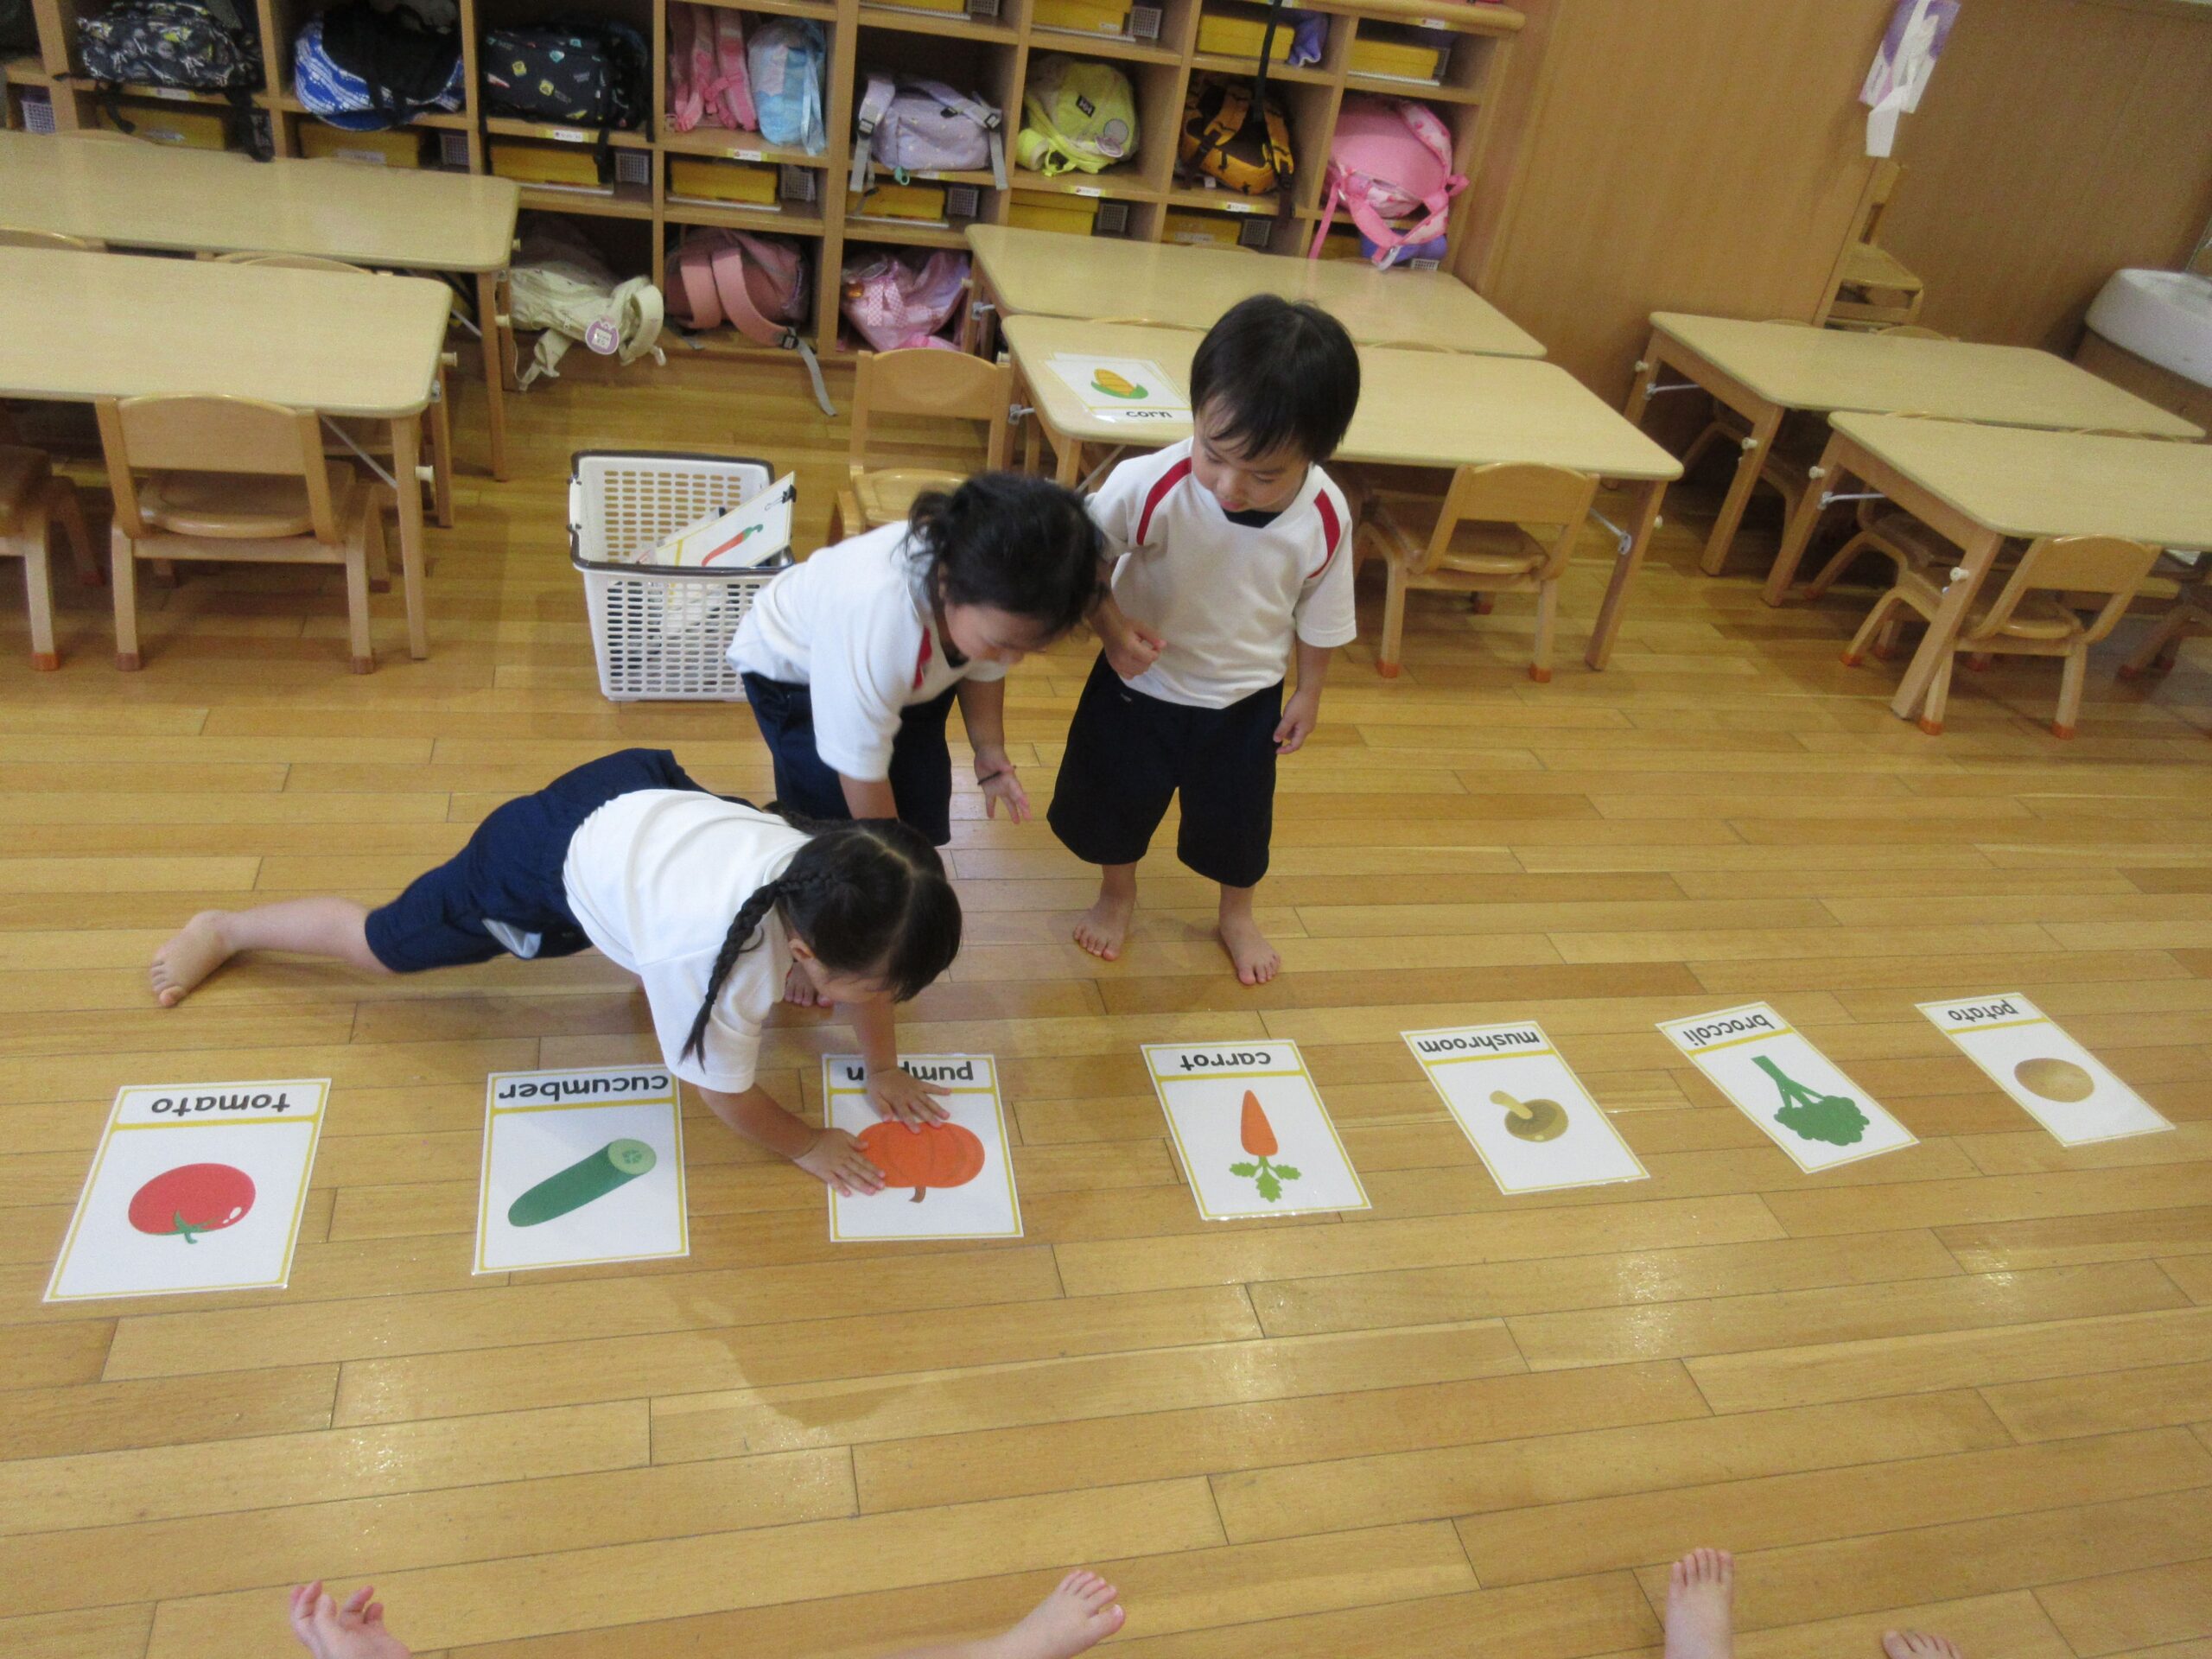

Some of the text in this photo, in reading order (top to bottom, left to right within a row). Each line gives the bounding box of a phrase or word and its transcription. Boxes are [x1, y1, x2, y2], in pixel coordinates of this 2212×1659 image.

[1125, 410, 1173, 419] corn
[1947, 999, 2019, 1023] potato
[1417, 1030, 1541, 1052] mushroom
[1682, 1014, 1776, 1046] broccoli
[846, 1060, 975, 1081] pumn
[1179, 1052, 1271, 1071] carrot
[498, 1075, 670, 1103] cucumber
[151, 1092, 291, 1117] tomato
